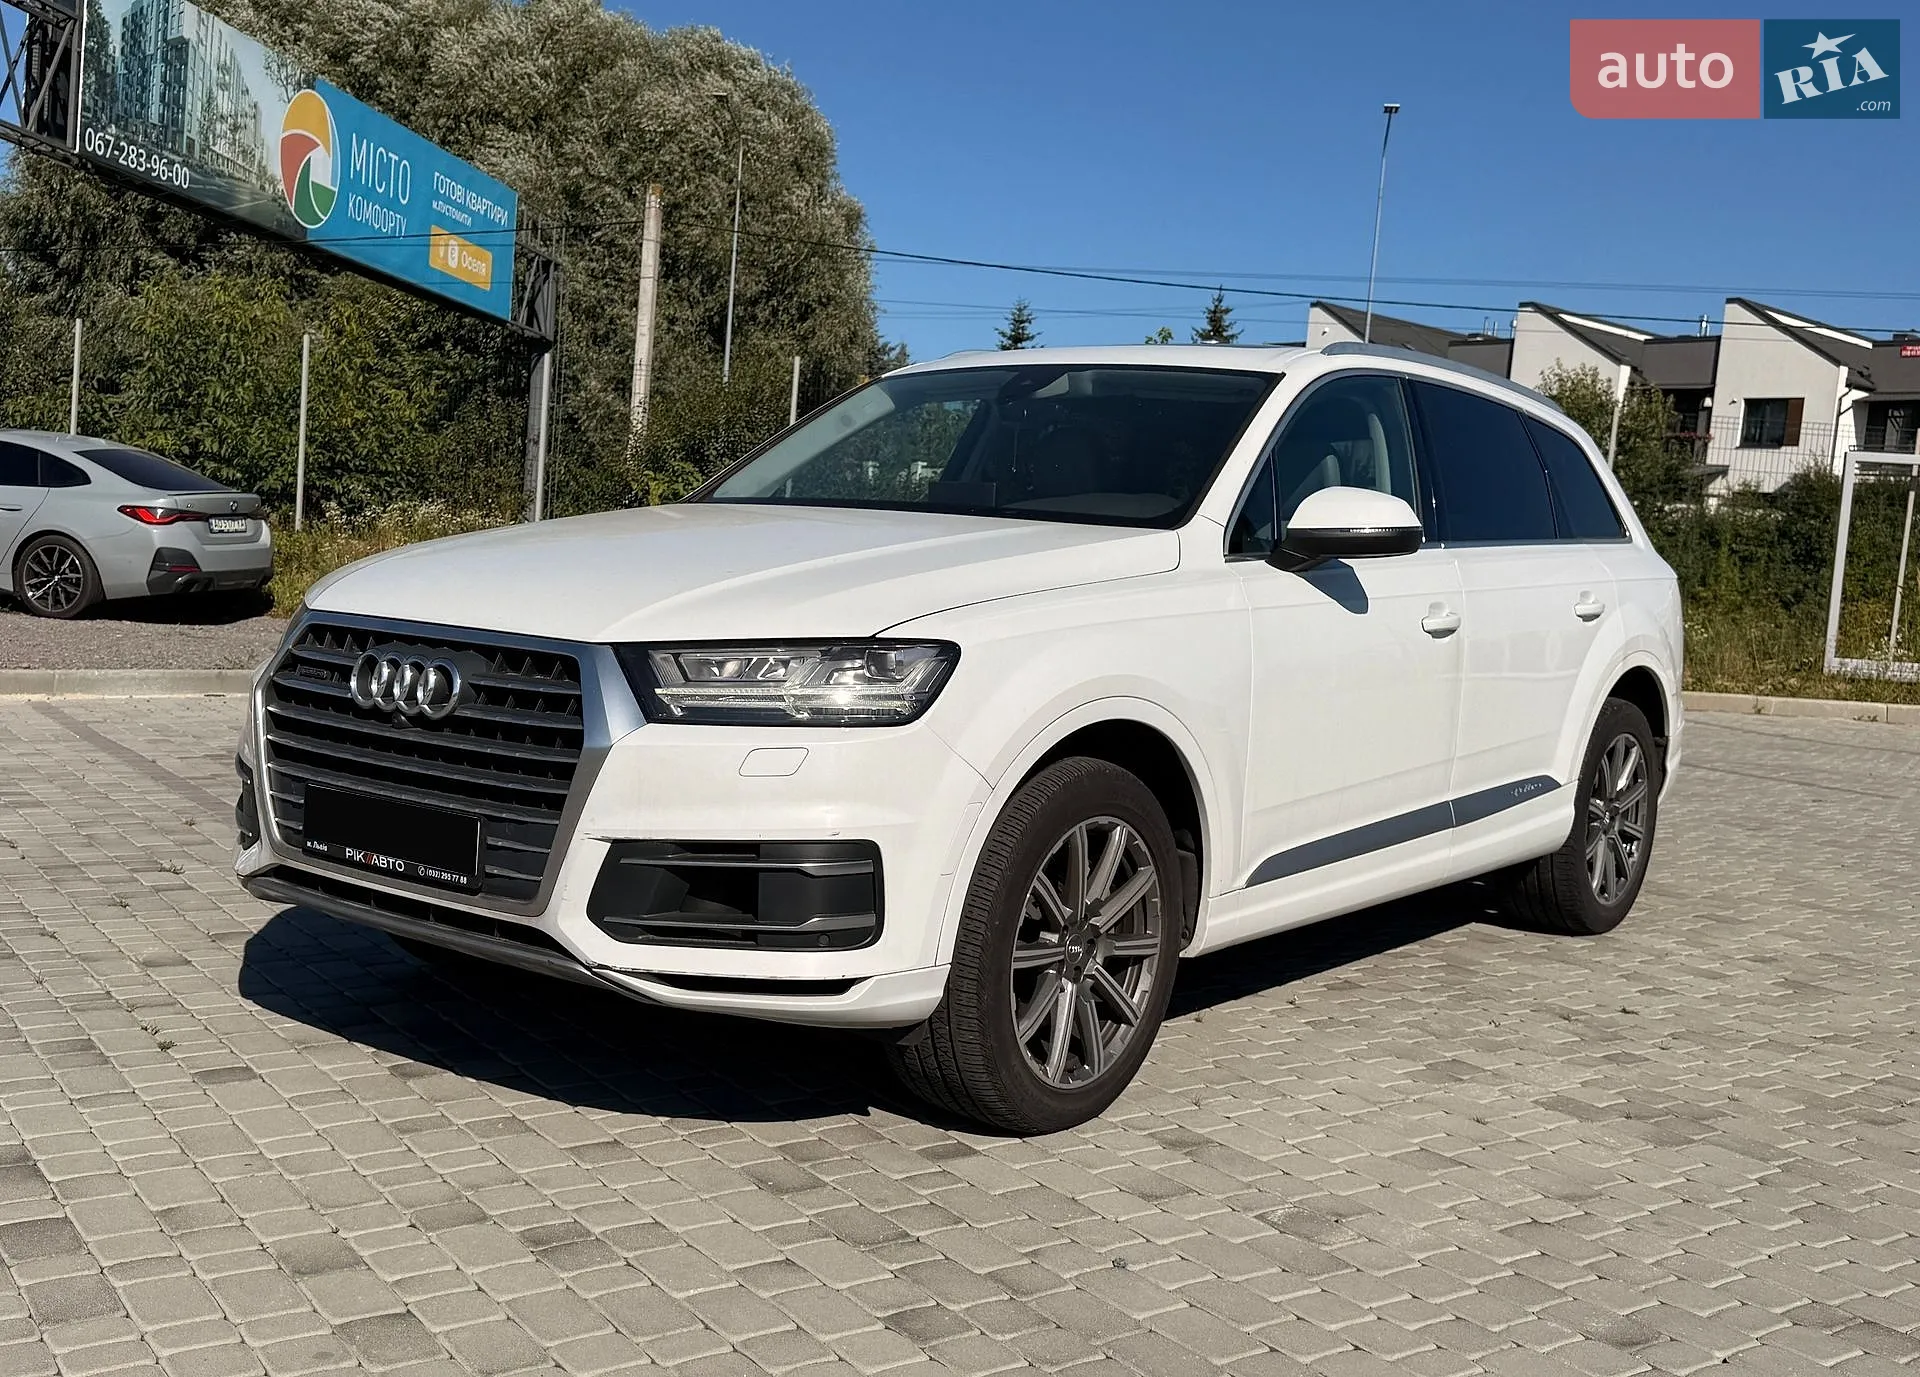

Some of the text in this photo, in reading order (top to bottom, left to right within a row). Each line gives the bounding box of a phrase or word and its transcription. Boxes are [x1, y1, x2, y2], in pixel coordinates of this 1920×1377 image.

[84, 127, 190, 190] 067-283-96-00
[350, 132, 411, 205] МІСТО
[348, 192, 408, 240] КОМФОРТУ
[433, 171, 509, 228] ГОТОВІ КВАРТИРИ
[452, 874, 459, 882] 77
